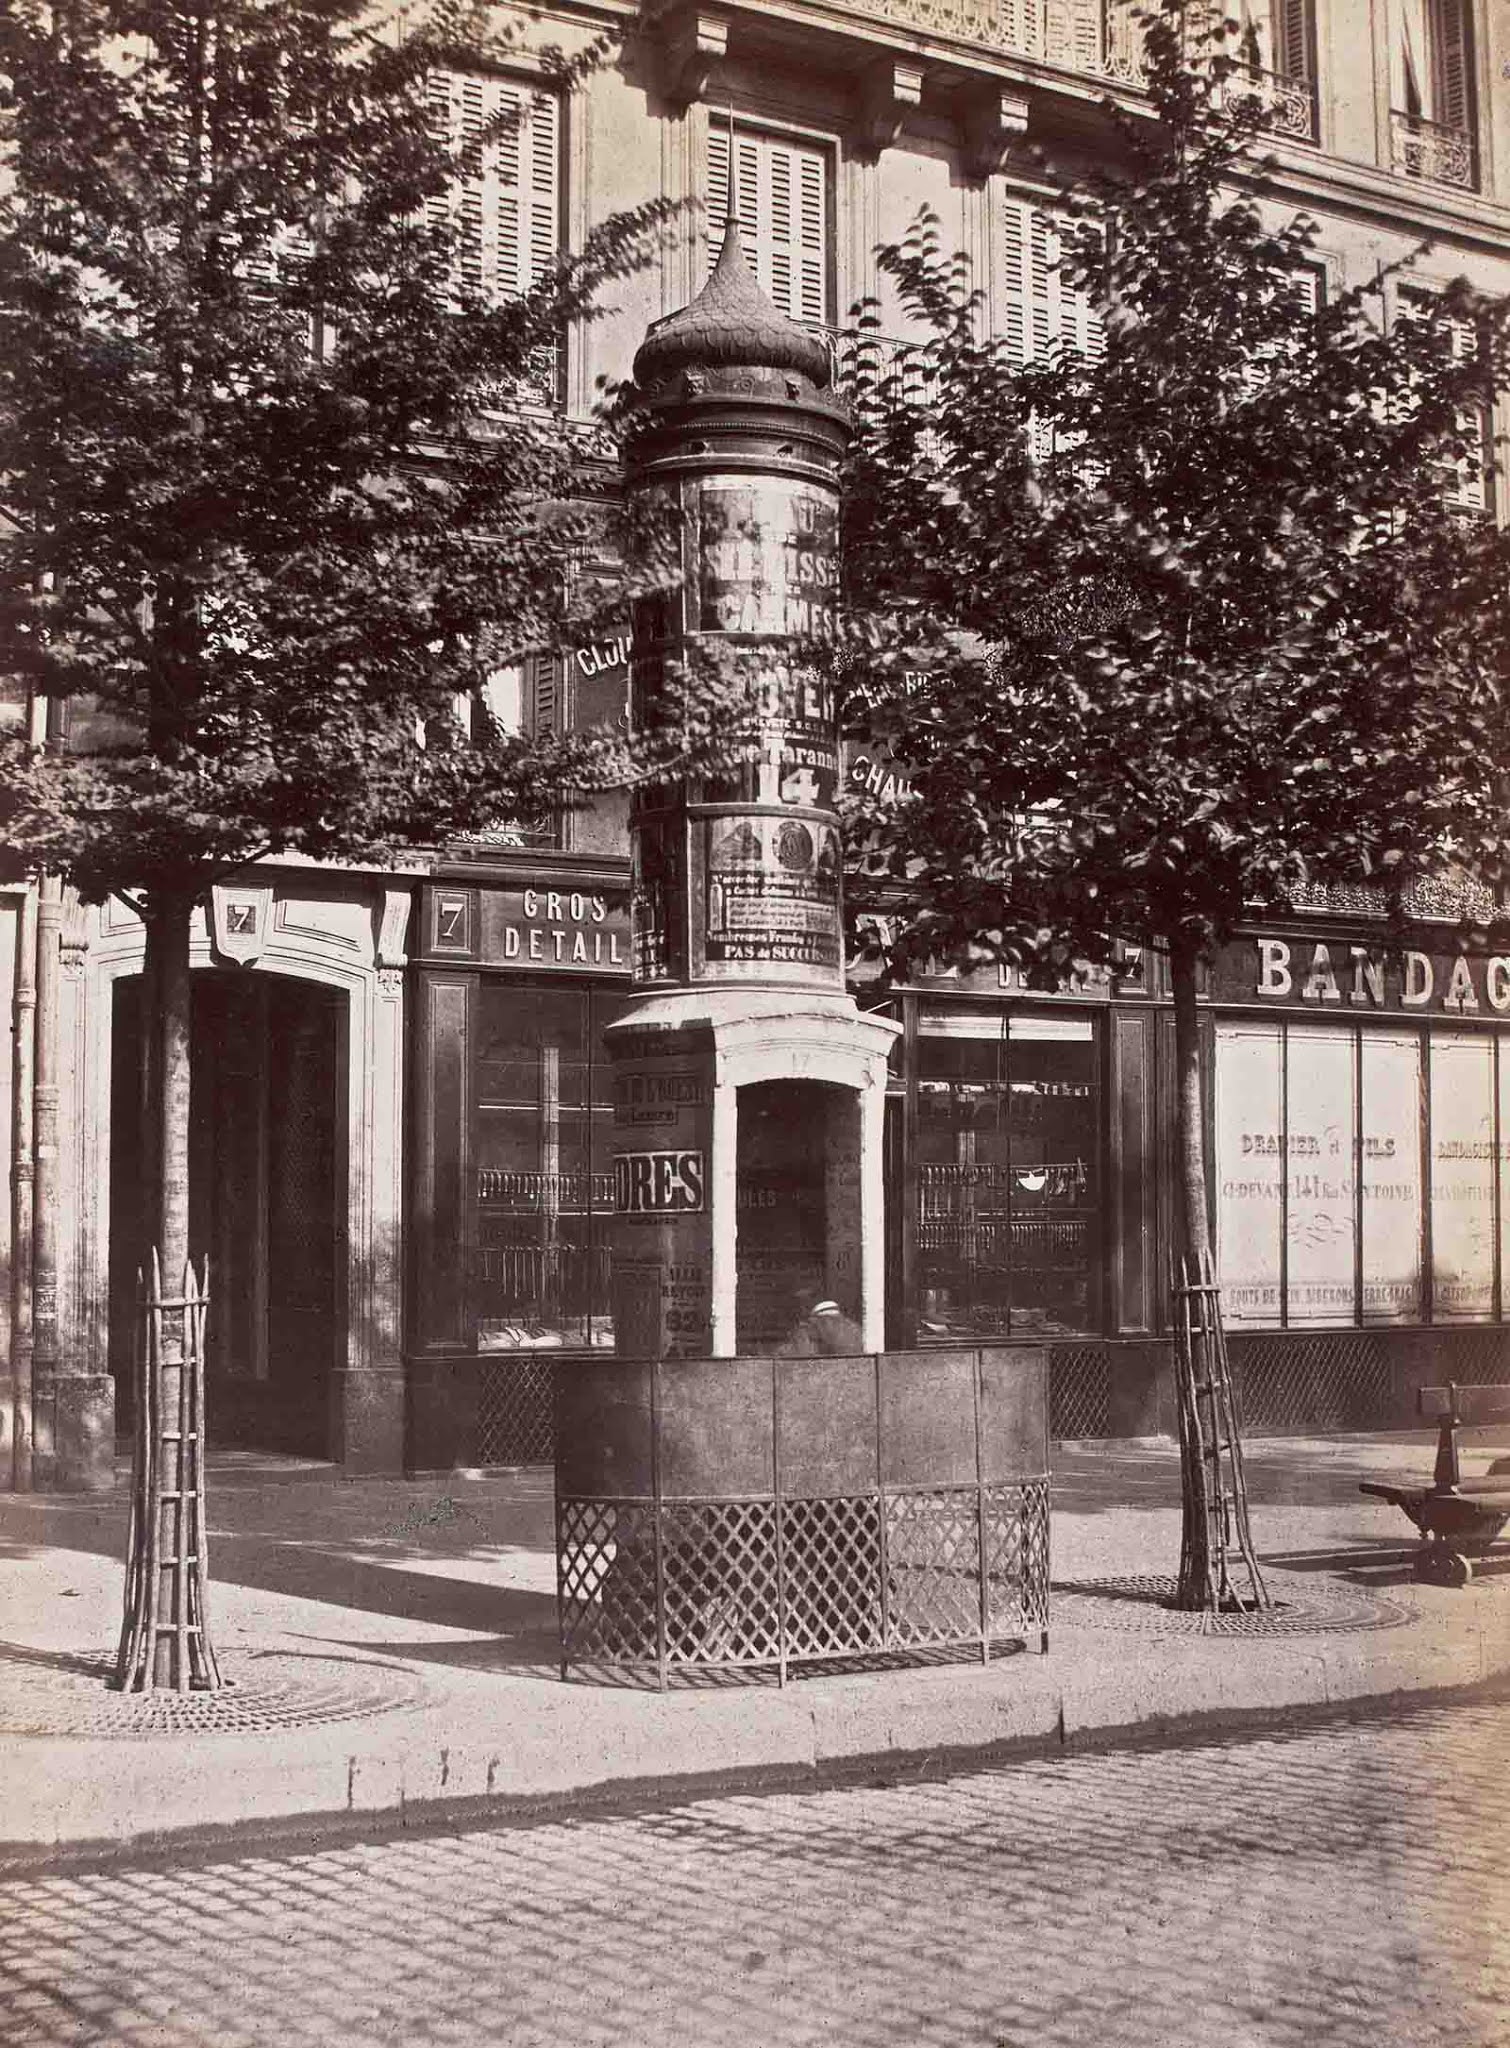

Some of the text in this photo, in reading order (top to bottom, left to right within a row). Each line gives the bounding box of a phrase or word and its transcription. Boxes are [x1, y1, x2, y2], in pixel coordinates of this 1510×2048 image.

[234, 906, 250, 931] 7
[441, 902, 464, 938] 7
[524, 889, 605, 921] GROS
[505, 927, 623, 964] DETAIL
[724, 945, 755, 959] PAS
[1123, 948, 1141, 978] 7
[1257, 938, 1510, 1010] BANDAG
[1242, 1134, 1320, 1156] DRAIER
[1353, 1137, 1396, 1158] ILS
